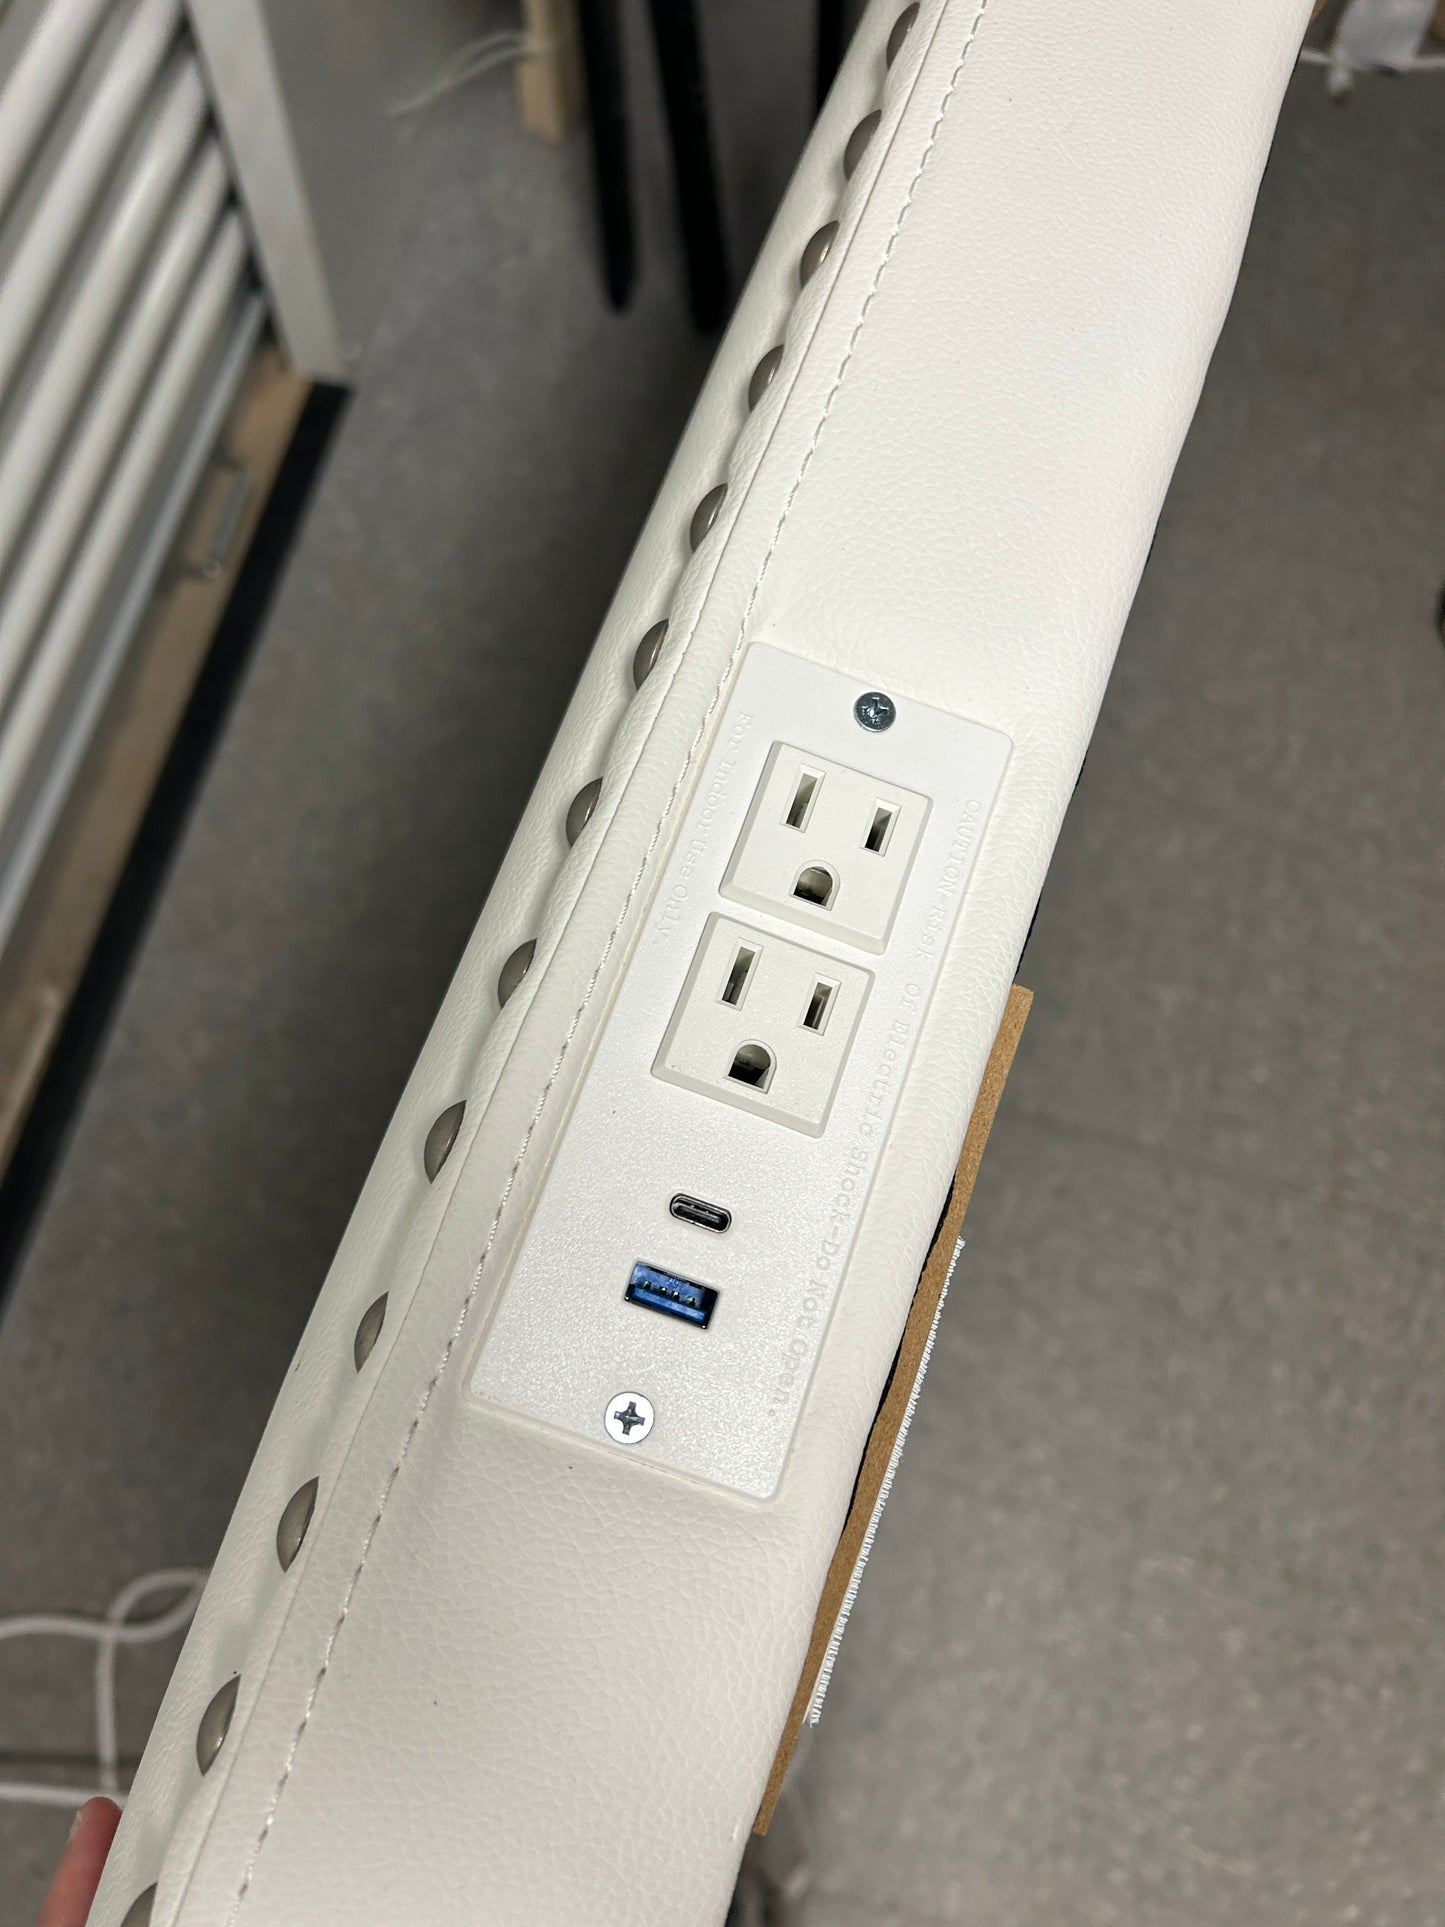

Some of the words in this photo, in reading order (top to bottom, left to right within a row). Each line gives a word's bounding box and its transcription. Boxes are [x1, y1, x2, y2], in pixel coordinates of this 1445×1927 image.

[727, 710, 753, 753] For
[695, 756, 736, 837] Indoor
[678, 839, 706, 879] Use
[900, 982, 920, 1013] Of
[859, 1019, 910, 1137] Electric
[796, 1278, 827, 1327] Not
[767, 1339, 807, 1417] Open.
